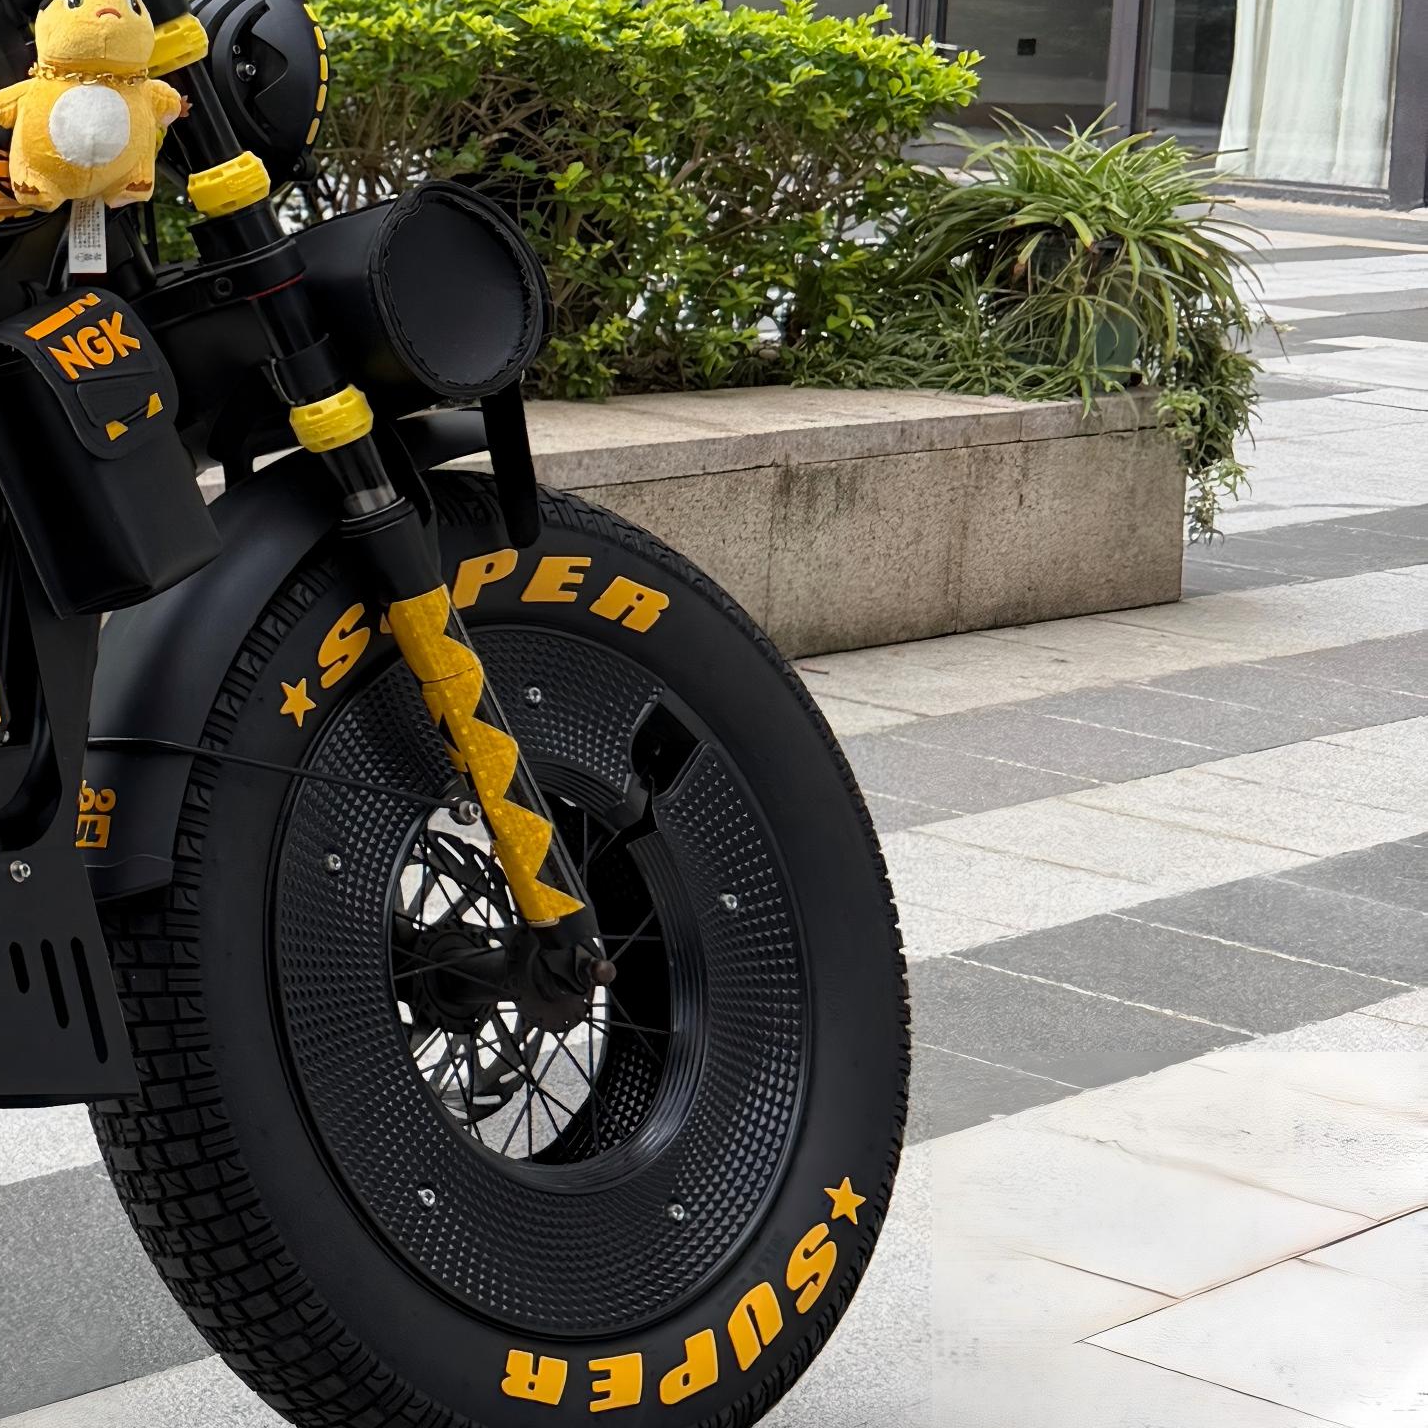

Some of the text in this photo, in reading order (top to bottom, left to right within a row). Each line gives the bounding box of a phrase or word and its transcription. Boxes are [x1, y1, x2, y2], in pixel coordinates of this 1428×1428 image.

[48, 311, 140, 380] NGK
[318, 548, 670, 689] SPER
[501, 1223, 837, 1413] SUPER
